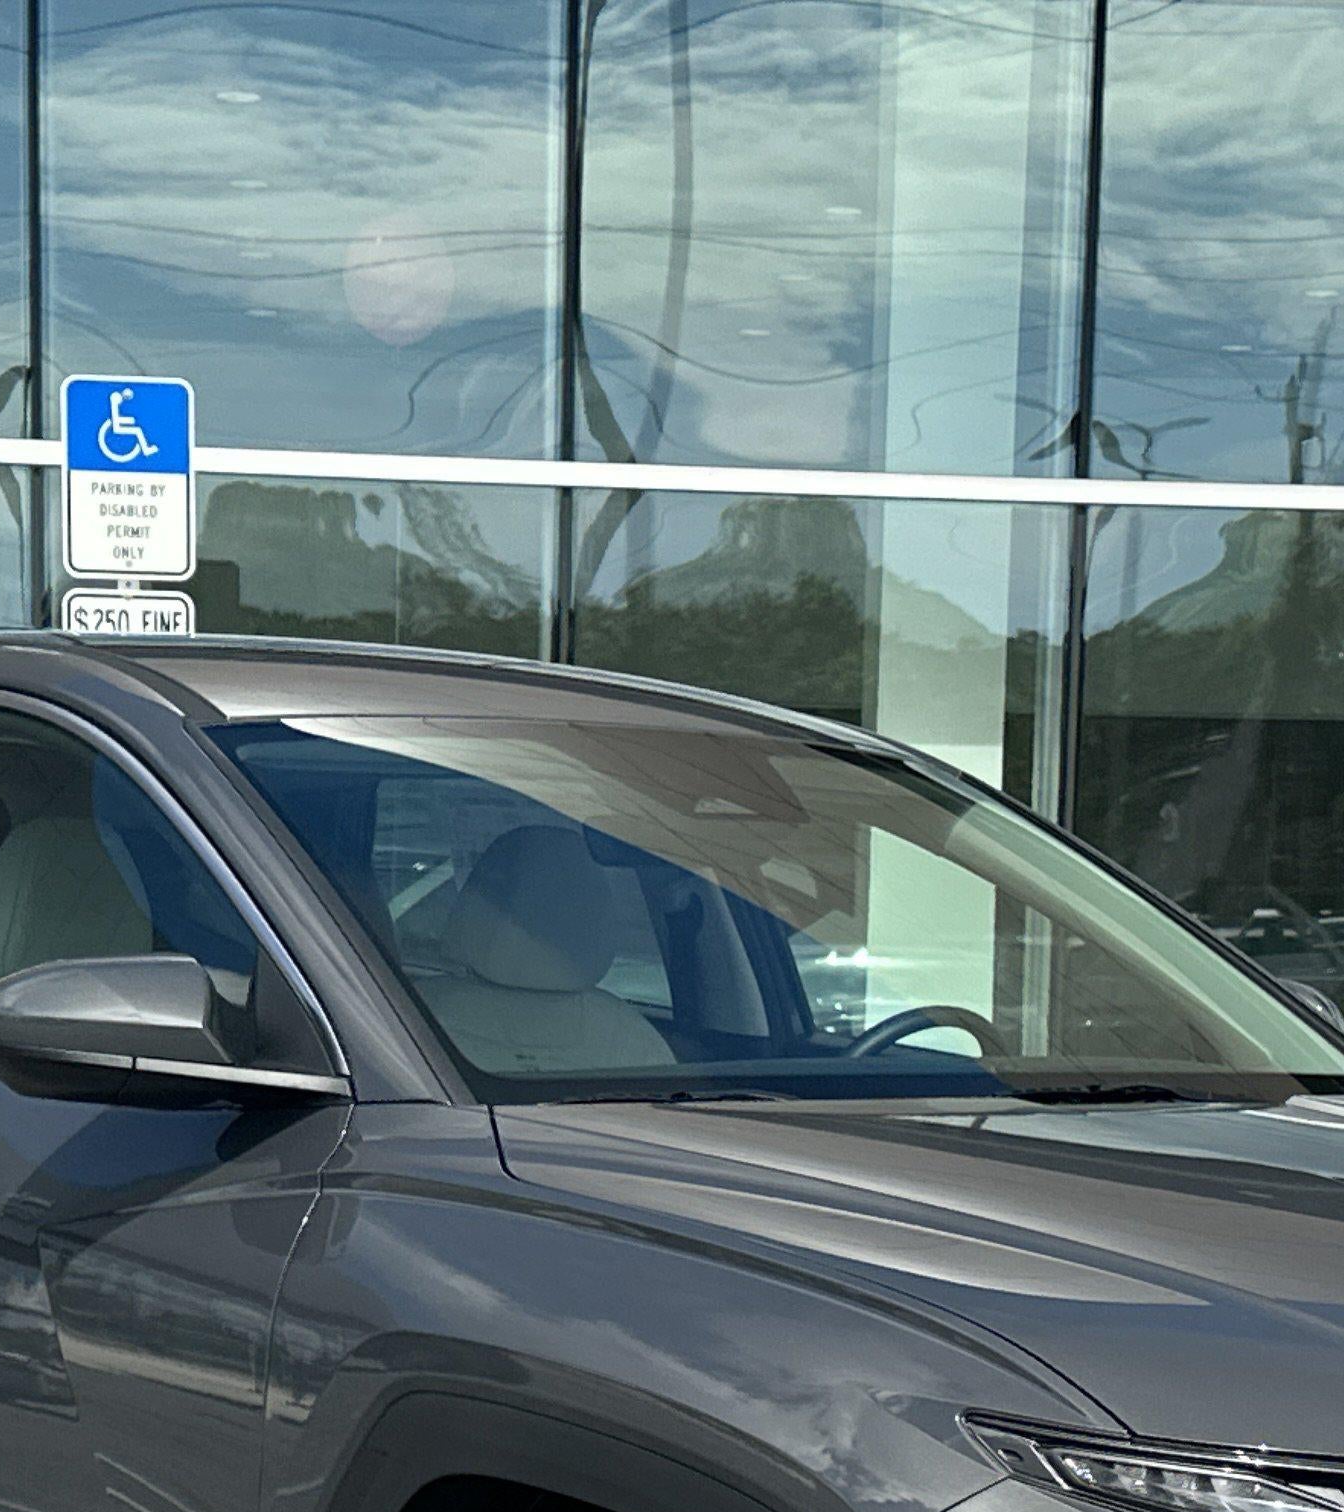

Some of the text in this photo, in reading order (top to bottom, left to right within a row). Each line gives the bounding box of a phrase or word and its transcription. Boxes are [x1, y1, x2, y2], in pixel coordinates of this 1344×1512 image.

[91, 482, 166, 497] PARKING BY
[99, 503, 159, 518] DISABLED
[106, 525, 151, 539] PERMIT
[112, 545, 145, 559] ONLY
[74, 606, 130, 632] $250
